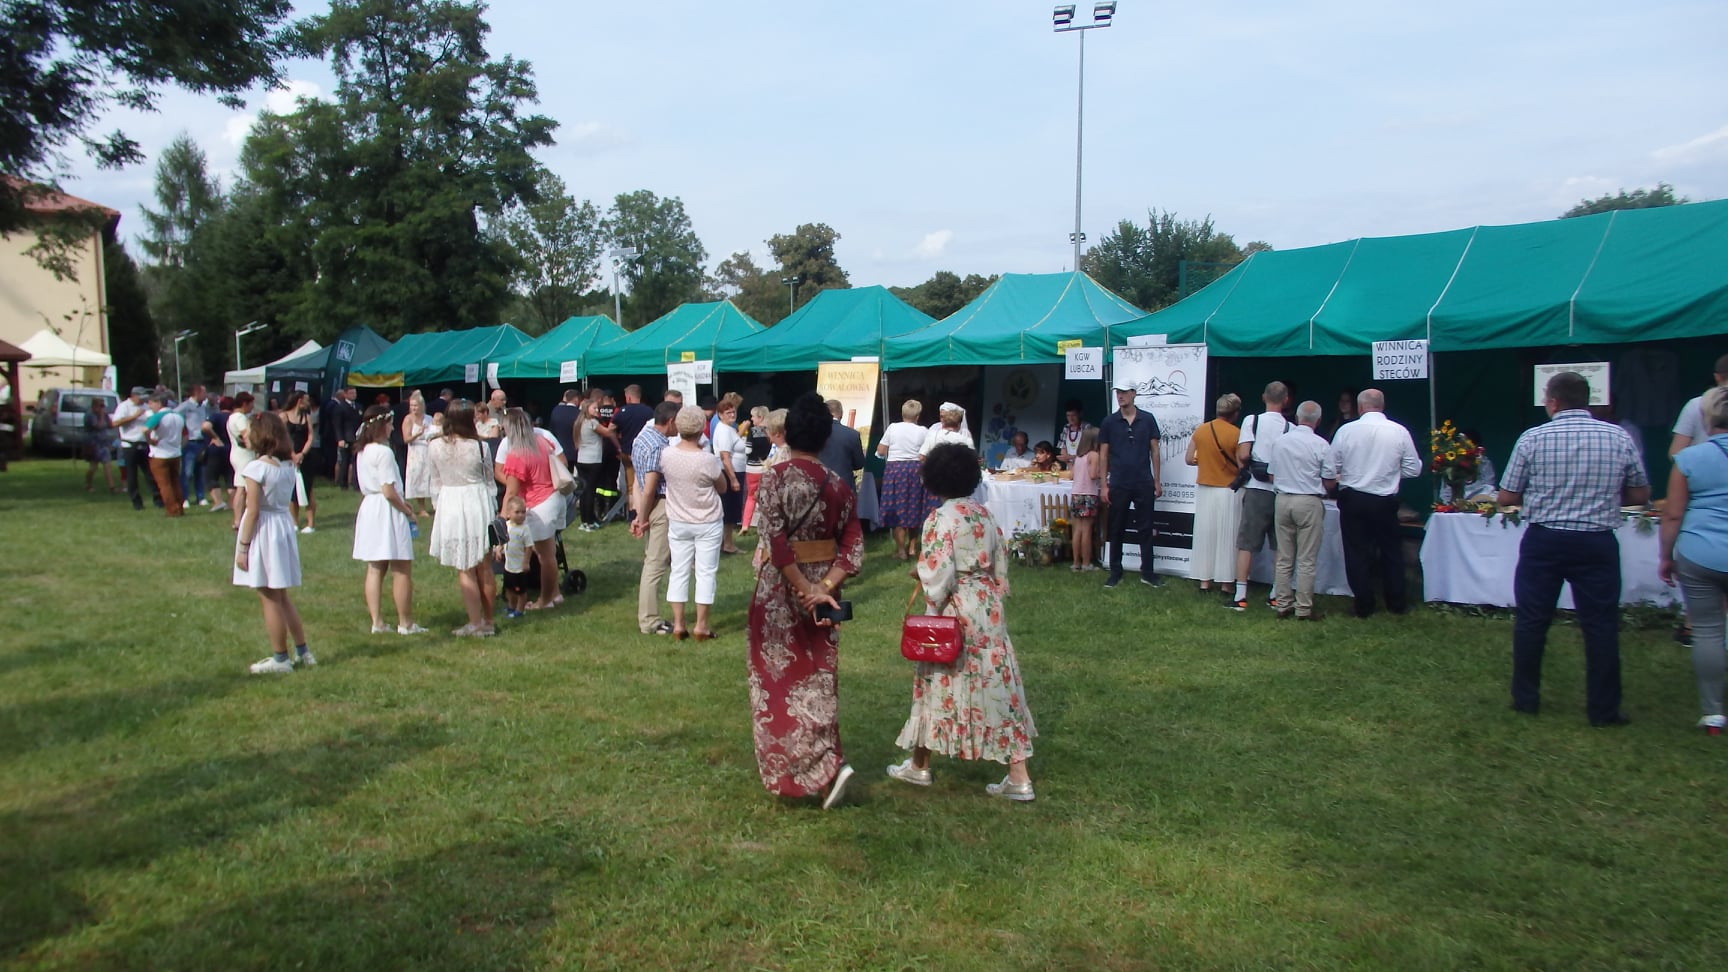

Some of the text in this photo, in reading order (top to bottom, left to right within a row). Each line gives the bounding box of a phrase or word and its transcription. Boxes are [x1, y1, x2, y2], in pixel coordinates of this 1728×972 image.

[1376, 340, 1423, 351] WINNICA
[1074, 352, 1091, 361] KGW
[1376, 354, 1423, 366] RODZINY
[1070, 364, 1096, 373] LUBCZA
[1379, 366, 1421, 379] STECÓW
[827, 371, 865, 381] WINNICA
[1168, 490, 1180, 498] 640
[1182, 491, 1195, 499] 955
